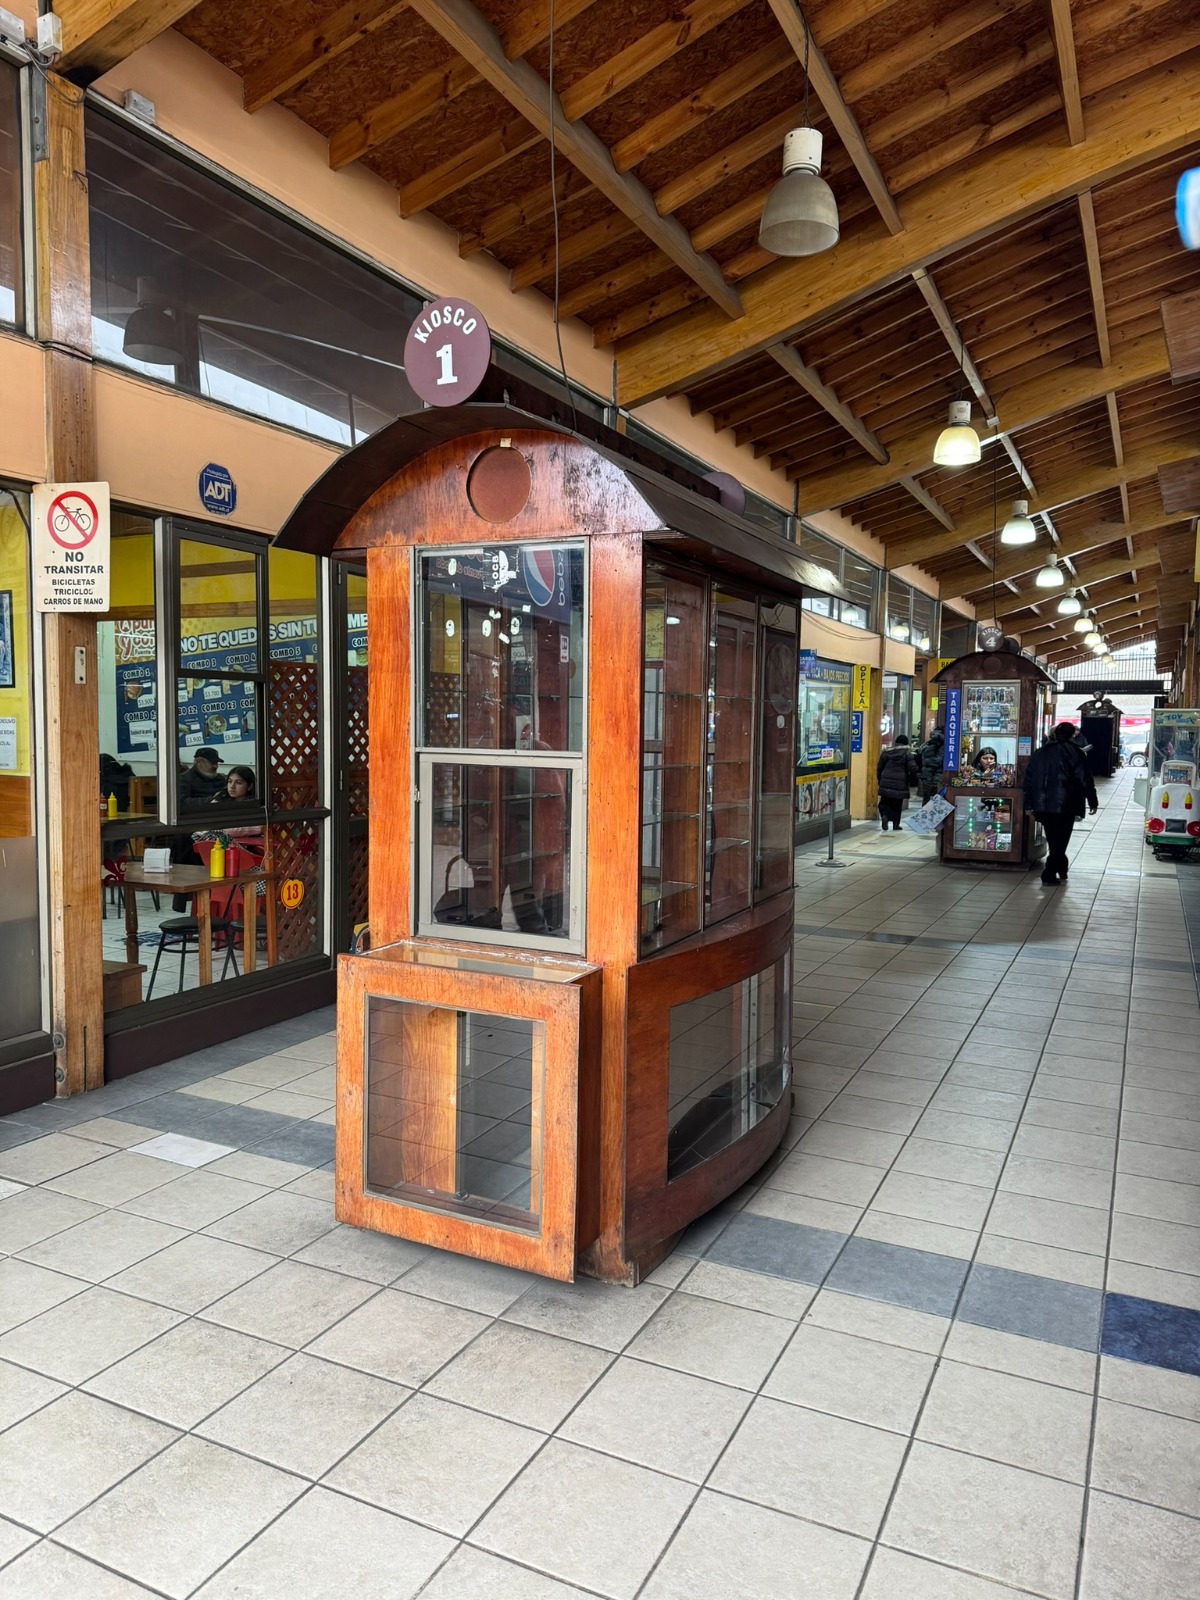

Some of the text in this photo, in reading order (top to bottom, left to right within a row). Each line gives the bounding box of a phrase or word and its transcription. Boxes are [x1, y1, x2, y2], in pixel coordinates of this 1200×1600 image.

[413, 305, 477, 344] KIOSCO
[435, 343, 458, 386] 1
[204, 480, 231, 502] ADT
[64, 551, 84, 562] NO
[44, 565, 104, 574] TRANSITAR
[491, 555, 499, 580] OCB
[52, 578, 95, 586] BICICLETAS
[181, 637, 198, 652] NO
[199, 634, 218, 650] TE
[277, 621, 302, 639] SIN
[982, 627, 1002, 637] KIOSCO
[986, 636, 997, 647] 4
[226, 652, 256, 665] COMBO 4
[270, 647, 294, 659] COMBO
[296, 646, 301, 655] 5
[187, 658, 217, 669] COMBO 3
[123, 669, 144, 680] COMBO
[859, 665, 867, 704] OPTICA
[201, 702, 226, 713] COMBO
[124, 711, 149, 722] COMBO
[948, 692, 957, 767] TABAQUERIA
[286, 883, 299, 900] 13
